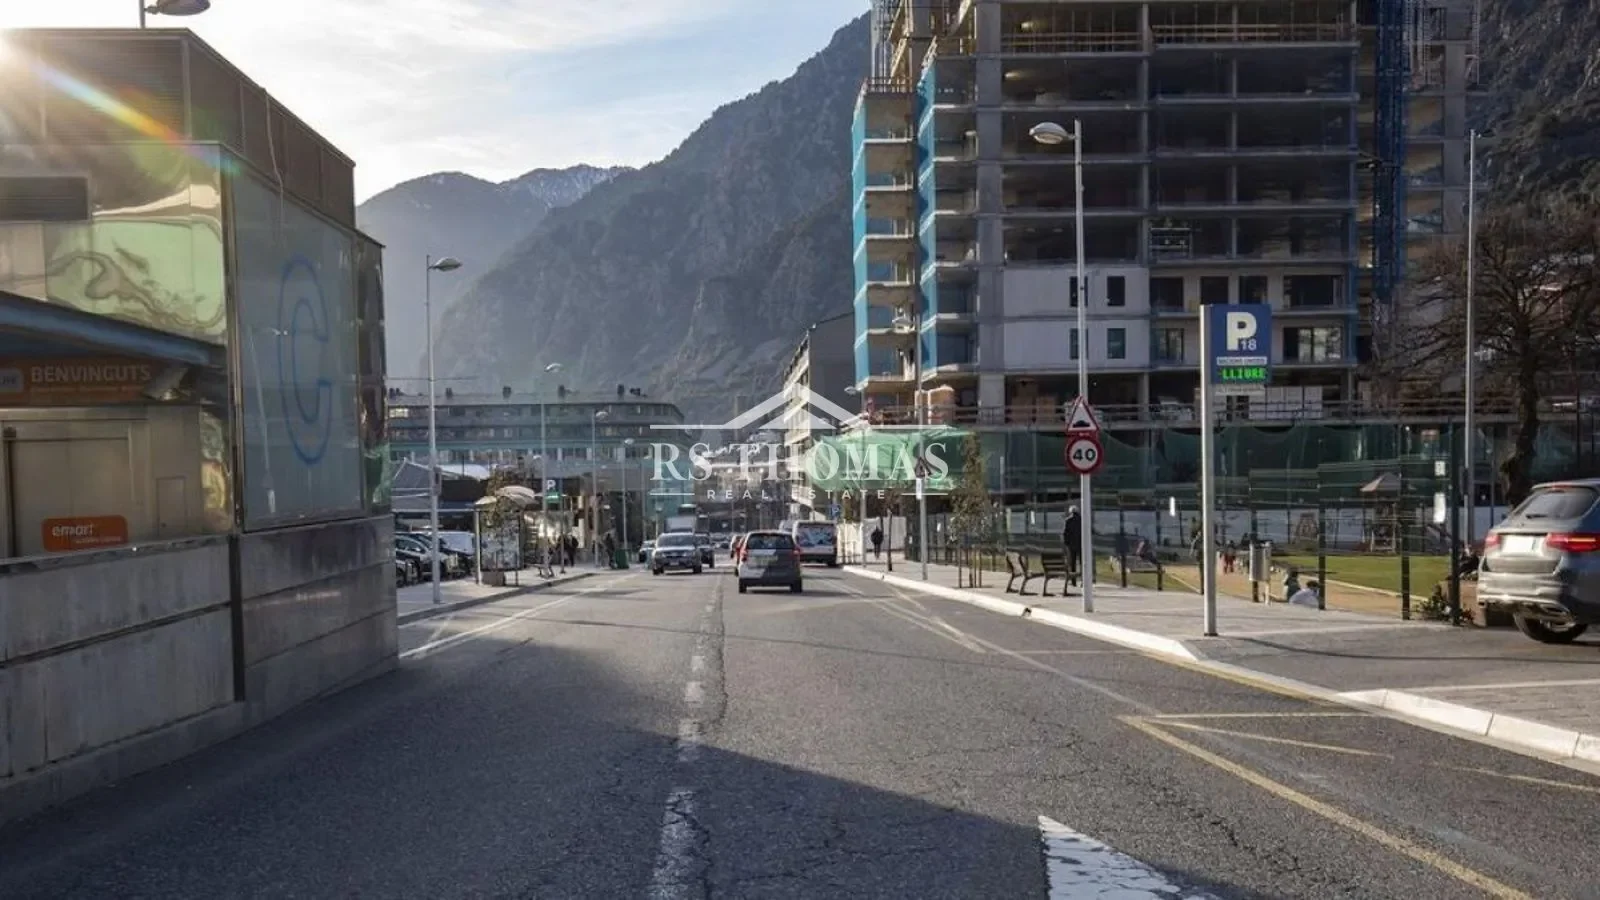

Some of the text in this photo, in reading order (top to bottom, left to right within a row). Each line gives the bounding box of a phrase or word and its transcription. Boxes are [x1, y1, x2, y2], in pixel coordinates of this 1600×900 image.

[1226, 311, 1257, 351] P
[1240, 338, 1257, 351] 18
[31, 364, 152, 383] BENVINGUTS
[1072, 448, 1096, 462] 40
